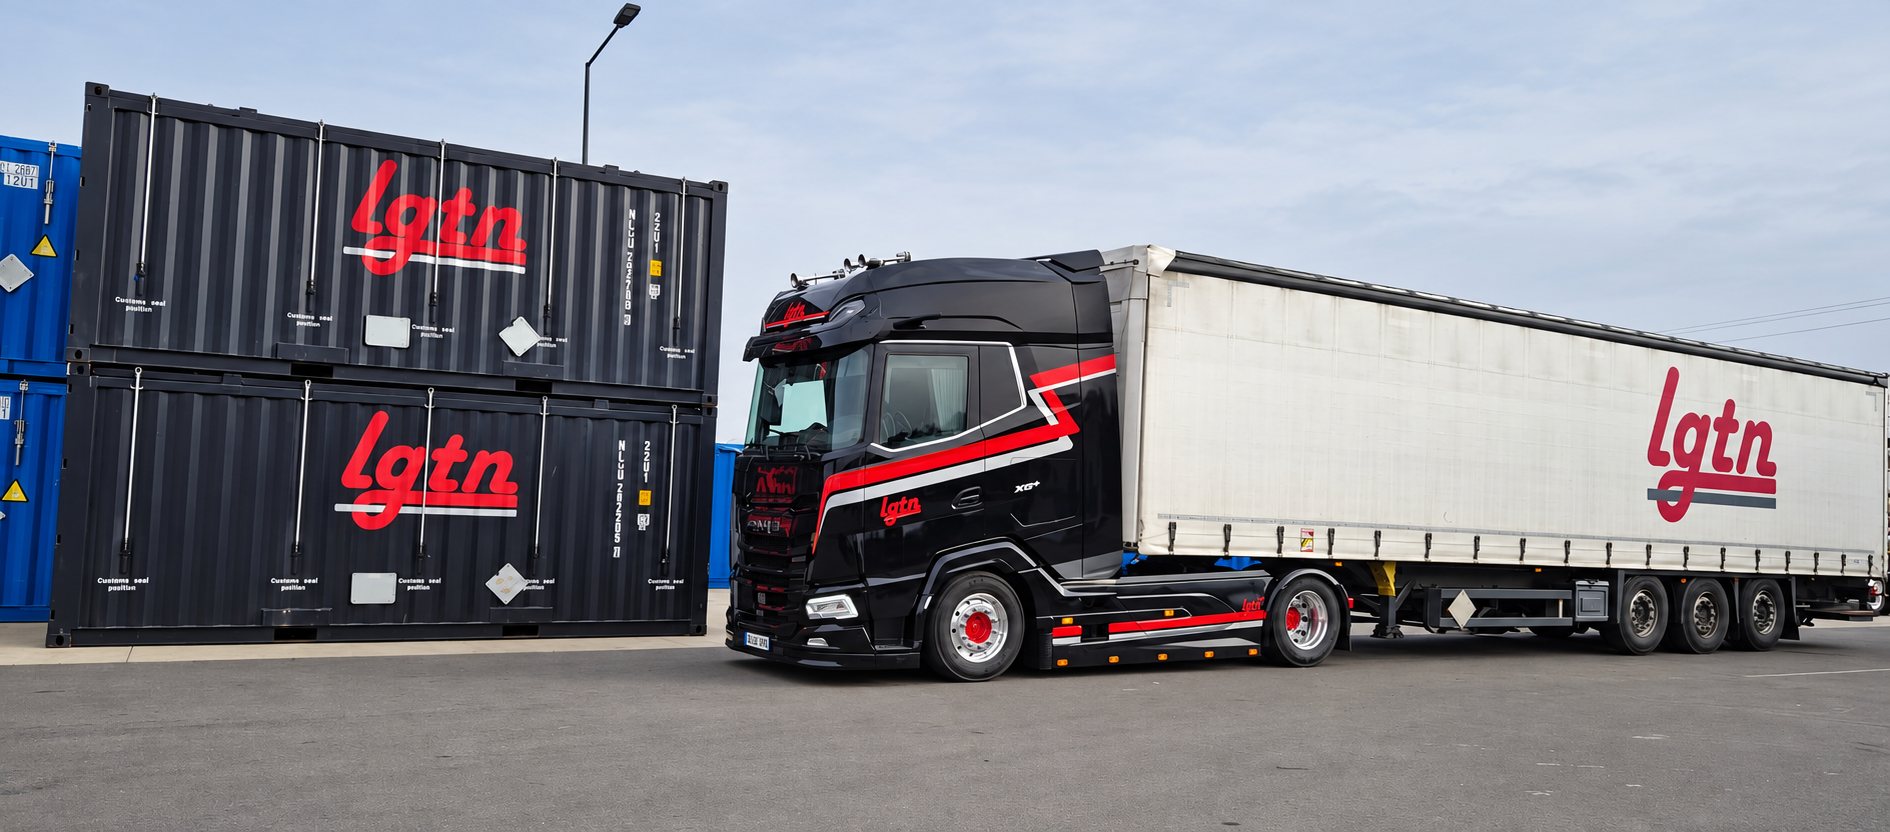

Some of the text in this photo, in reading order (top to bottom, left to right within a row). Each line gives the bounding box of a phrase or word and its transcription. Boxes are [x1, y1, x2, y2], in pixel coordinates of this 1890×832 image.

[352, 159, 527, 276] lgtn
[653, 212, 661, 254] 22U1
[341, 410, 519, 531] lgtn
[643, 440, 651, 483] 22U1
[1647, 366, 1777, 523] lgtn
[880, 496, 922, 527] lgtn
